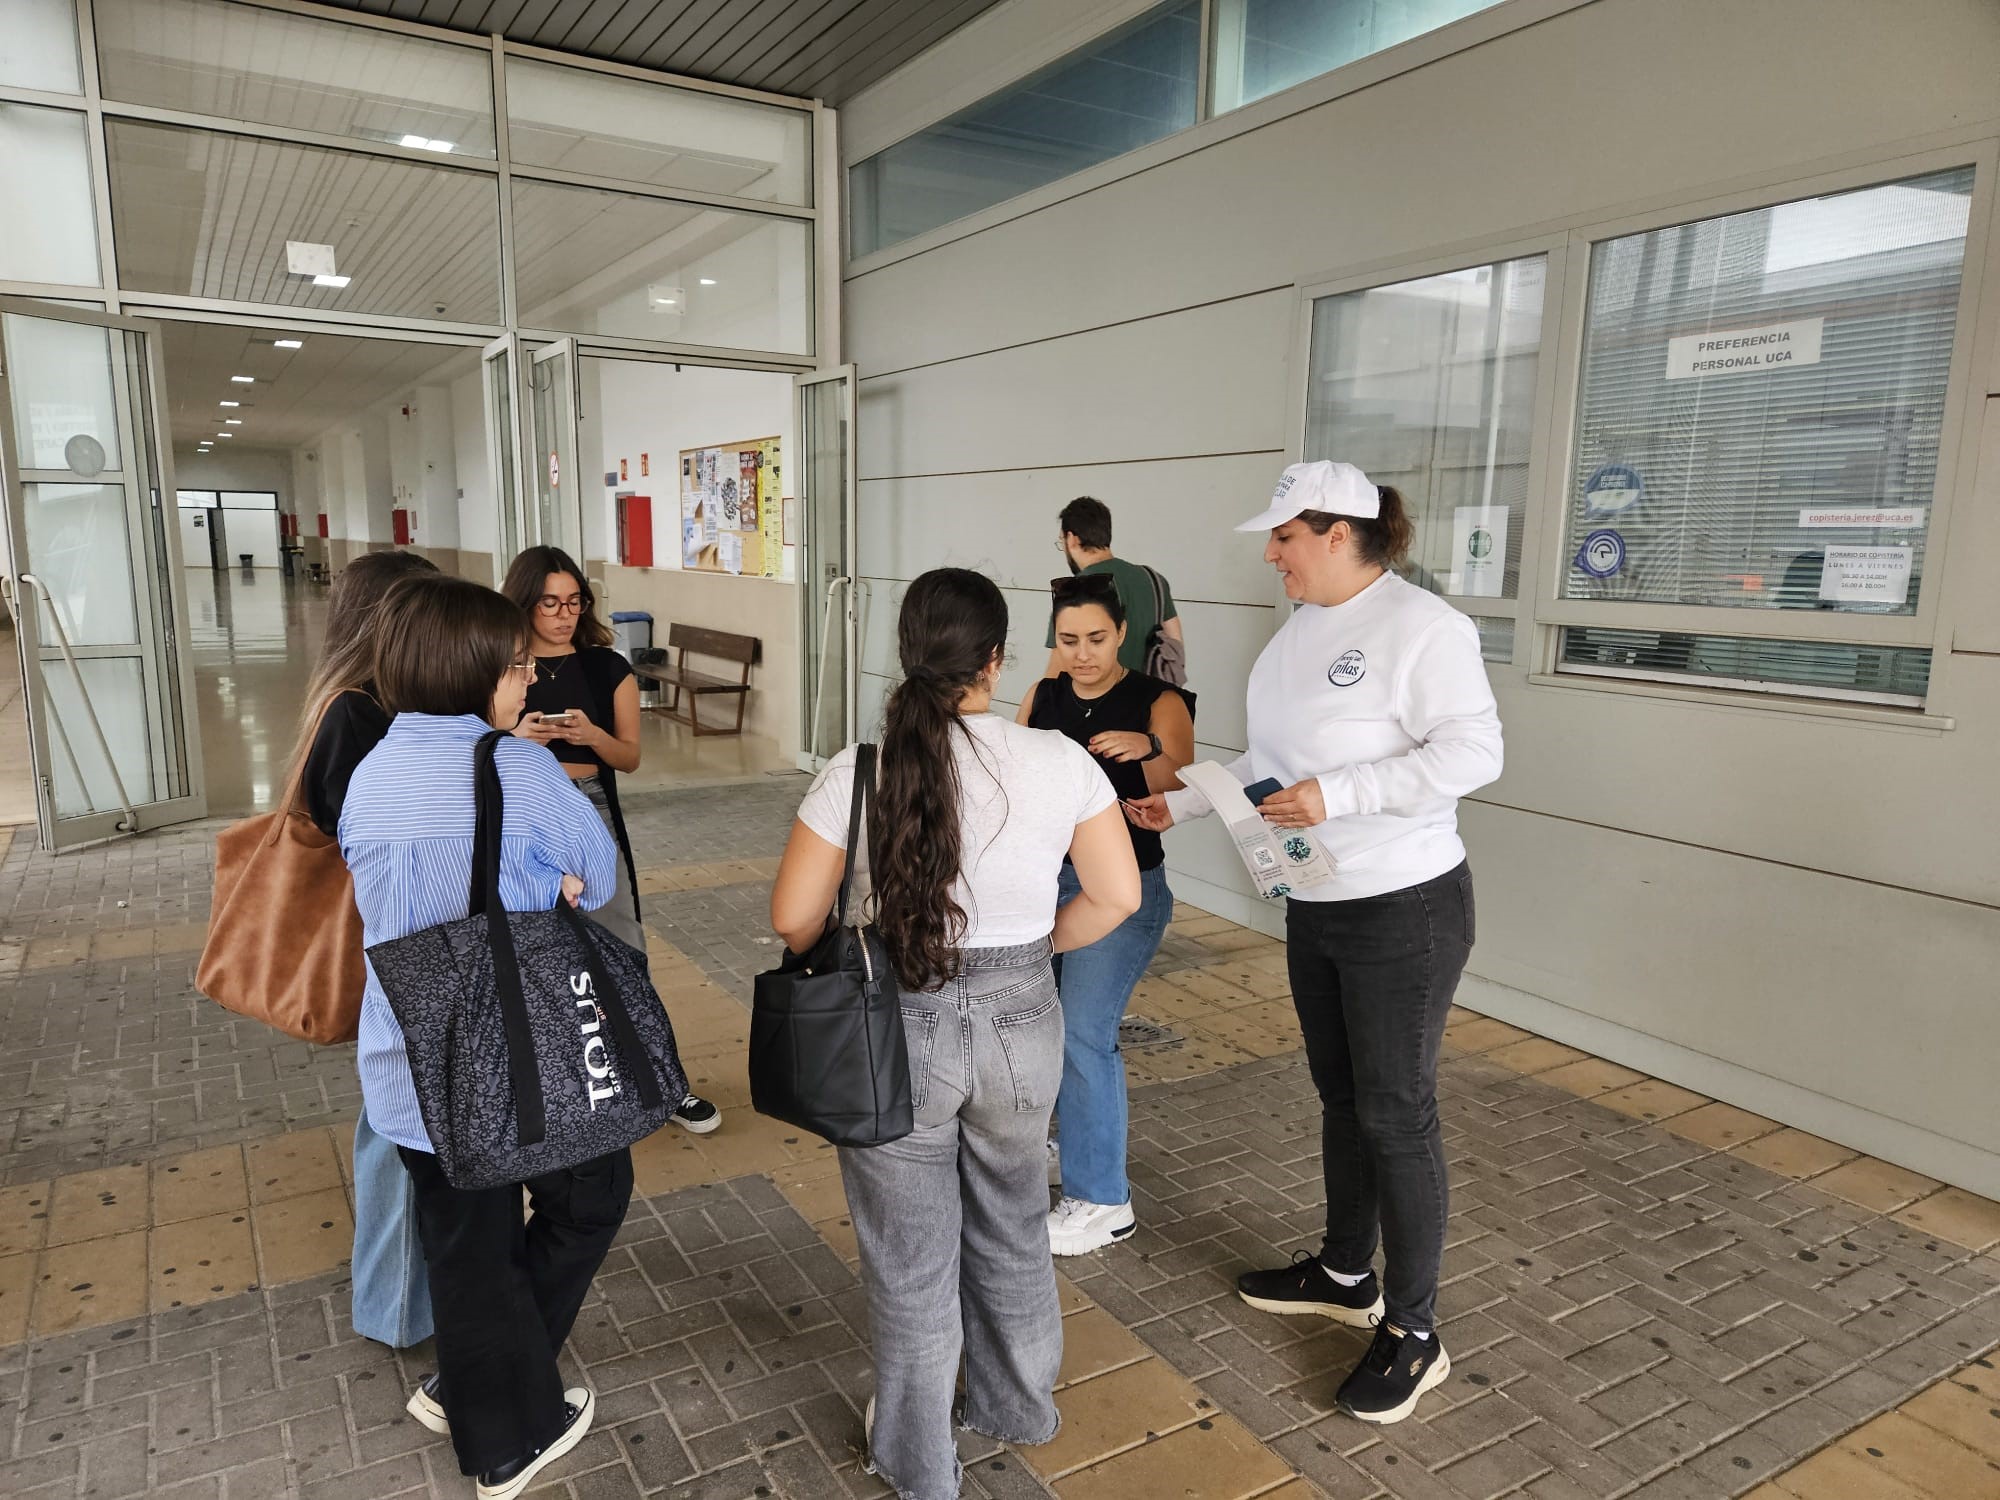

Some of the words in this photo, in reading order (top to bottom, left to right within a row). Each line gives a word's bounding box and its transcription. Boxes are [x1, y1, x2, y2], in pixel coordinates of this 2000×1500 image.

[1698, 332, 1790, 352] PREFERENCIA
[1692, 355, 1760, 372] PERSONAL
[1765, 350, 1792, 363] UCA
[1808, 513, 1914, 524] copisteria.jerez@uca.es
[1332, 660, 1359, 676] pilas
[570, 971, 615, 1112] TOUS
